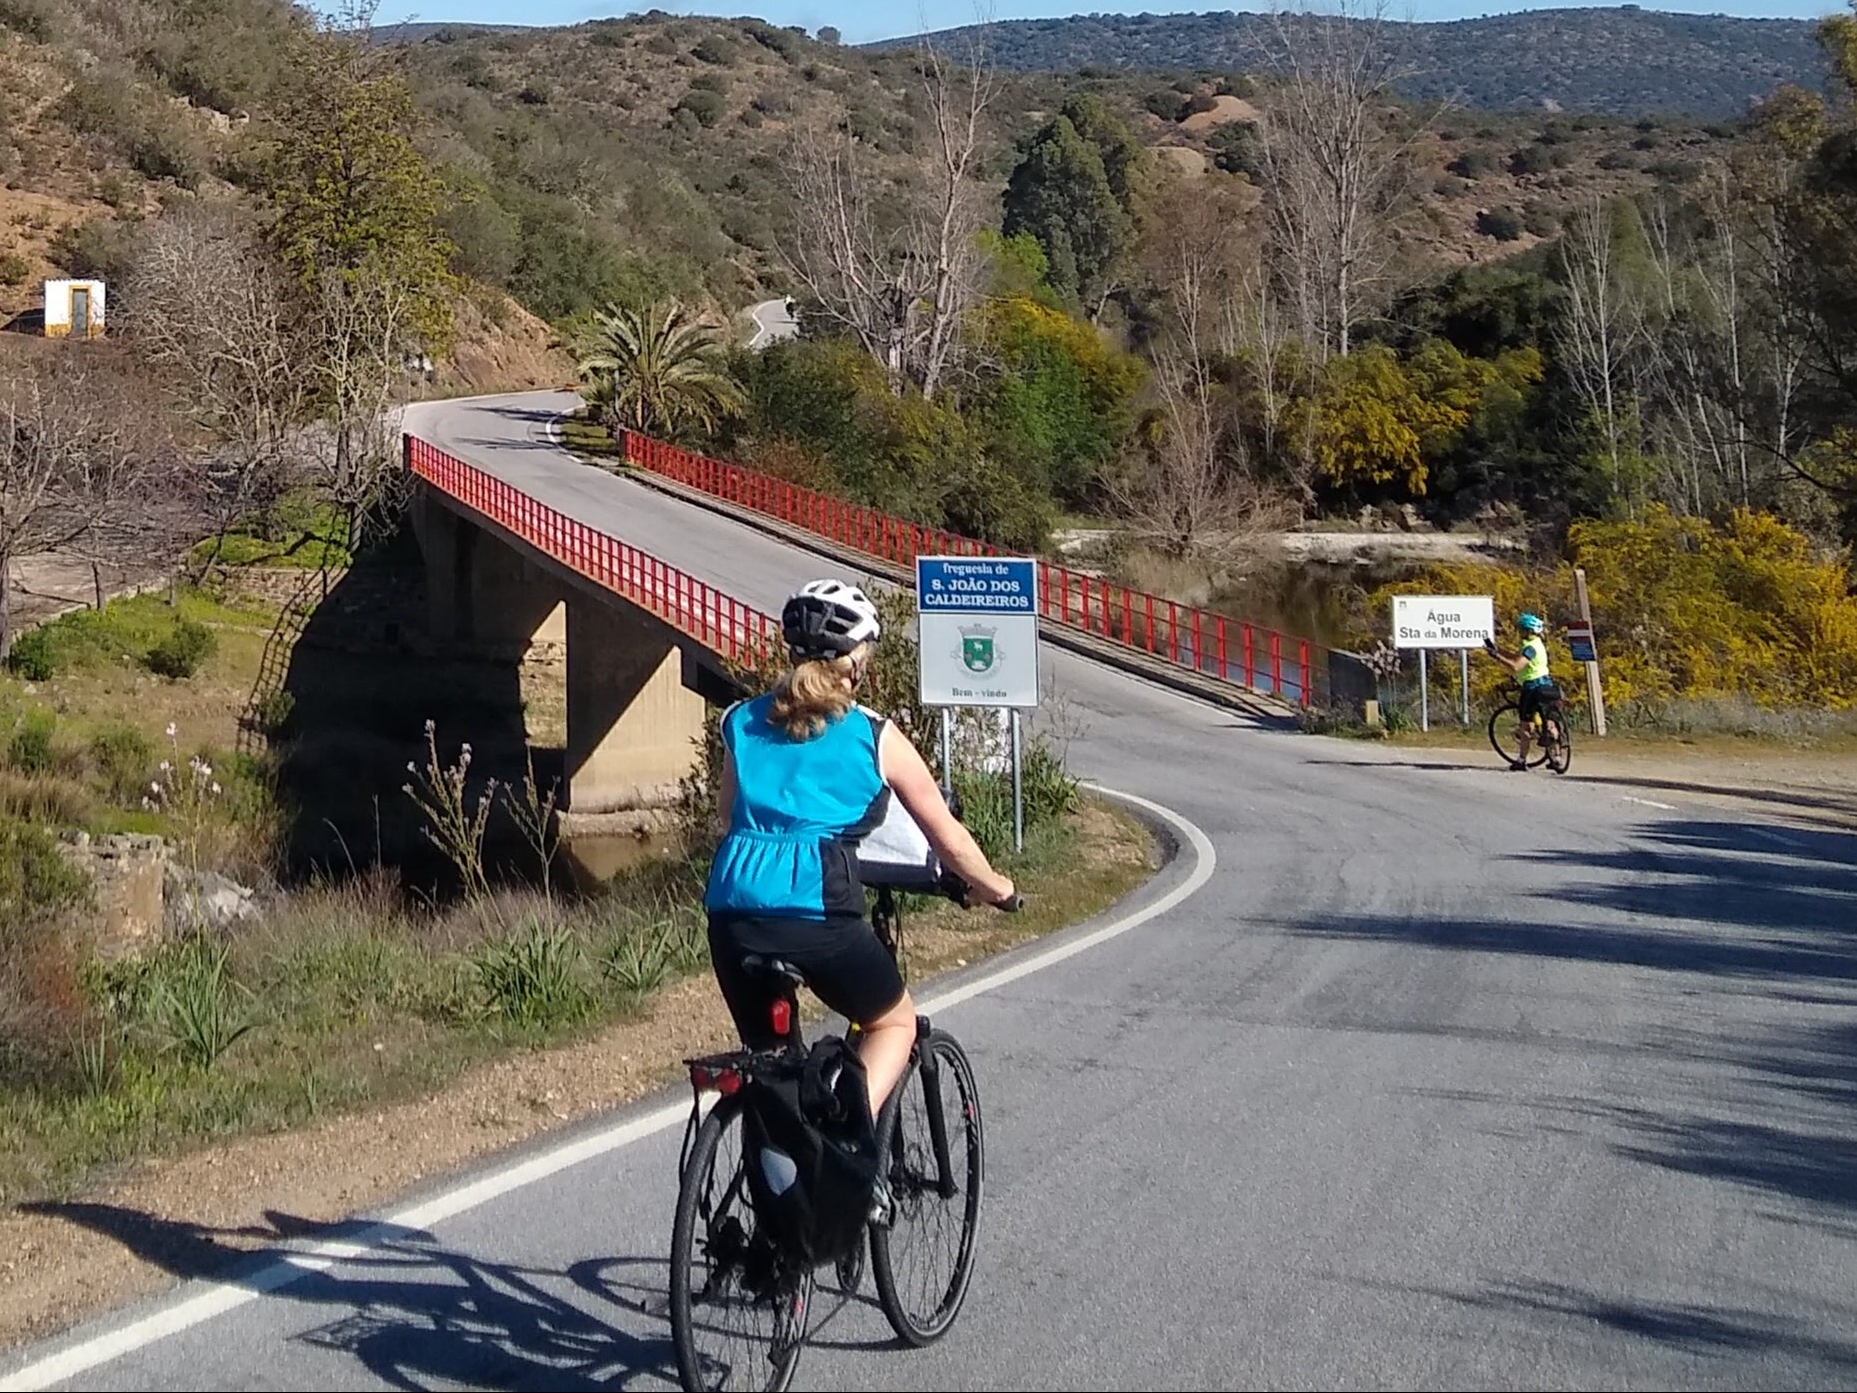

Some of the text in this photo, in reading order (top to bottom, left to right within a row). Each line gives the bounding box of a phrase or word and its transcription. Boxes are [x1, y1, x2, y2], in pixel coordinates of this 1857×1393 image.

[943, 563, 1009, 575] freguesia de
[932, 578, 1020, 592] S. JOÃO DOS
[925, 594, 1029, 607] CALDEIREIROS
[1427, 608, 1461, 625] Água
[1400, 627, 1489, 639] Sta da Morena
